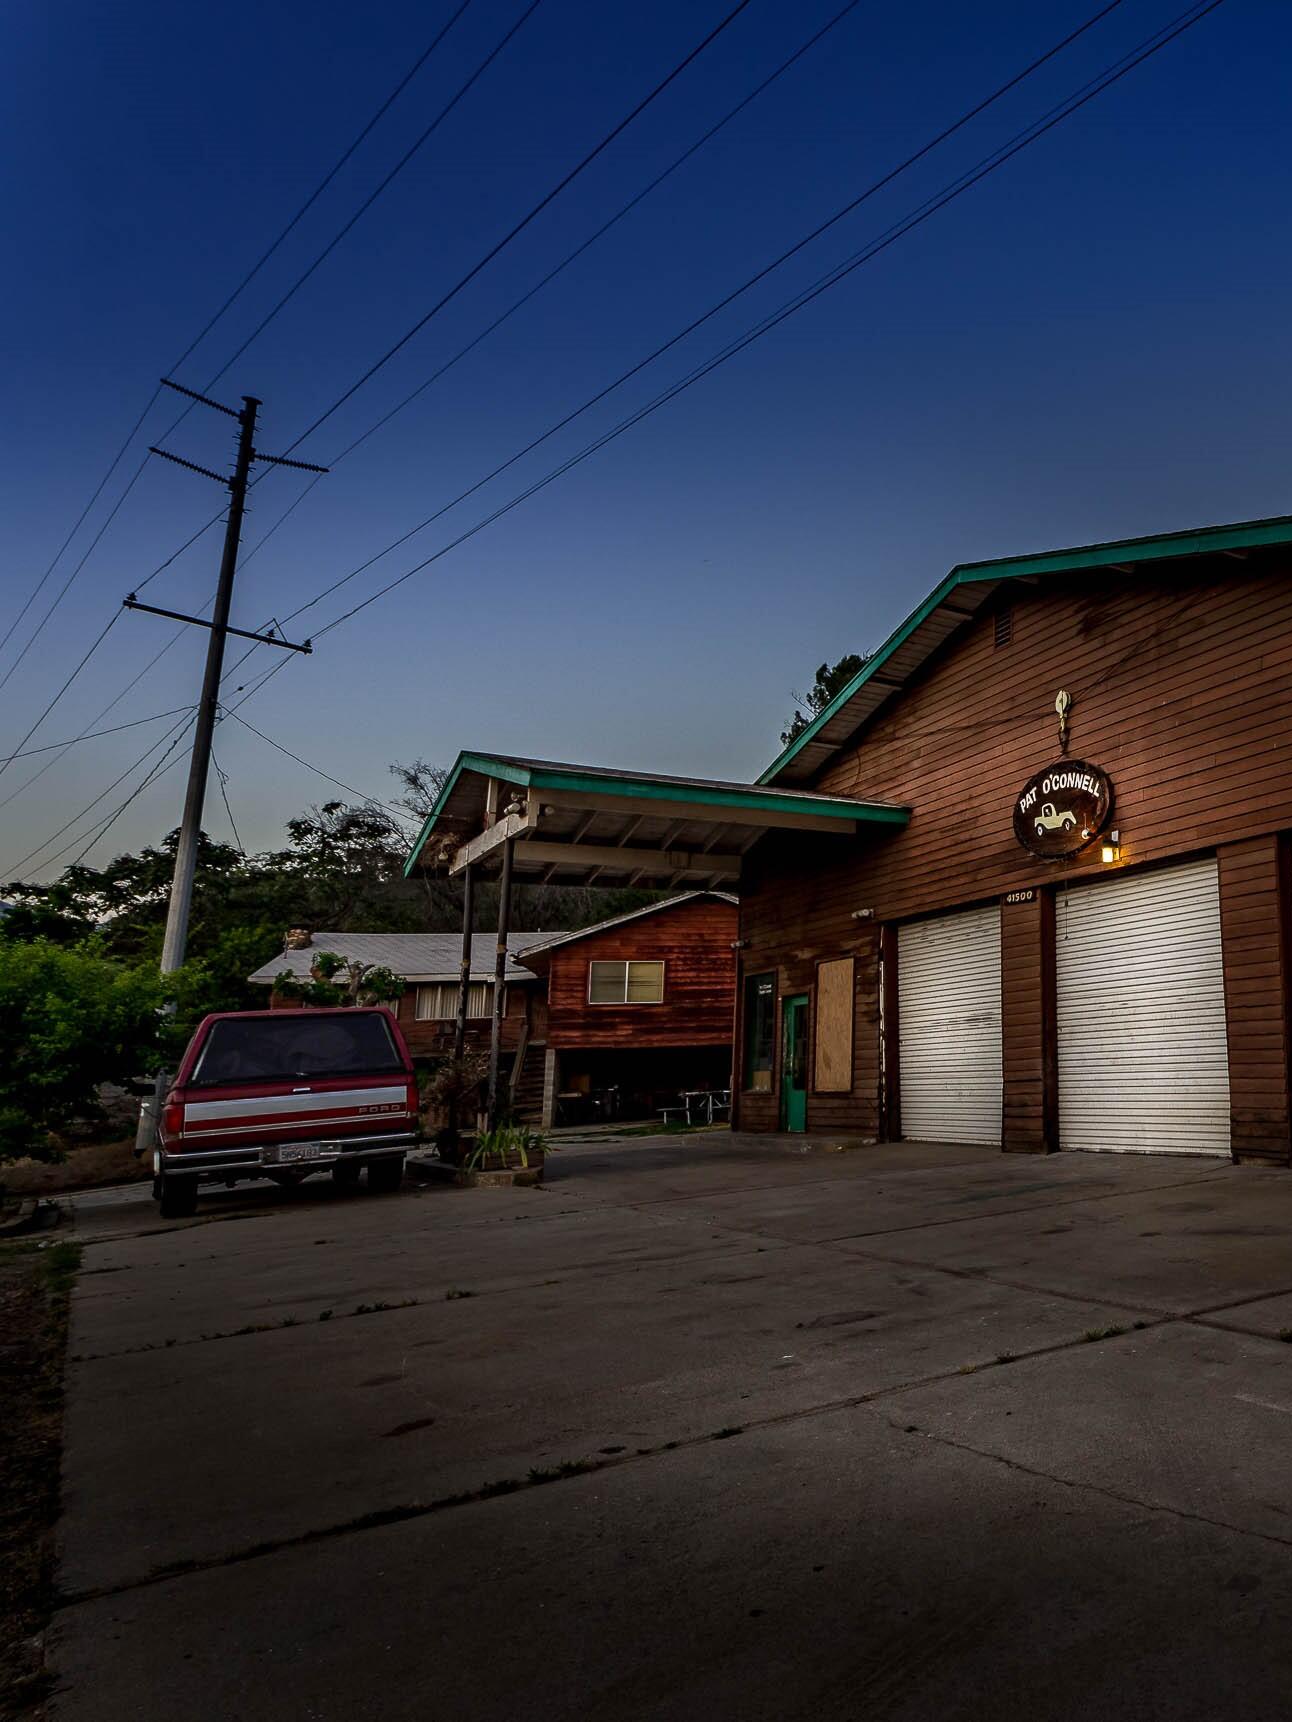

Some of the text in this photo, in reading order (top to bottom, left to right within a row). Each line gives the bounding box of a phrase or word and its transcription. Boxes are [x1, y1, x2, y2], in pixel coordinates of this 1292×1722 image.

[1019, 772, 1100, 814] PAT O'CONNELL
[1006, 890, 1033, 903] 41500
[358, 1104, 401, 1114] FORD
